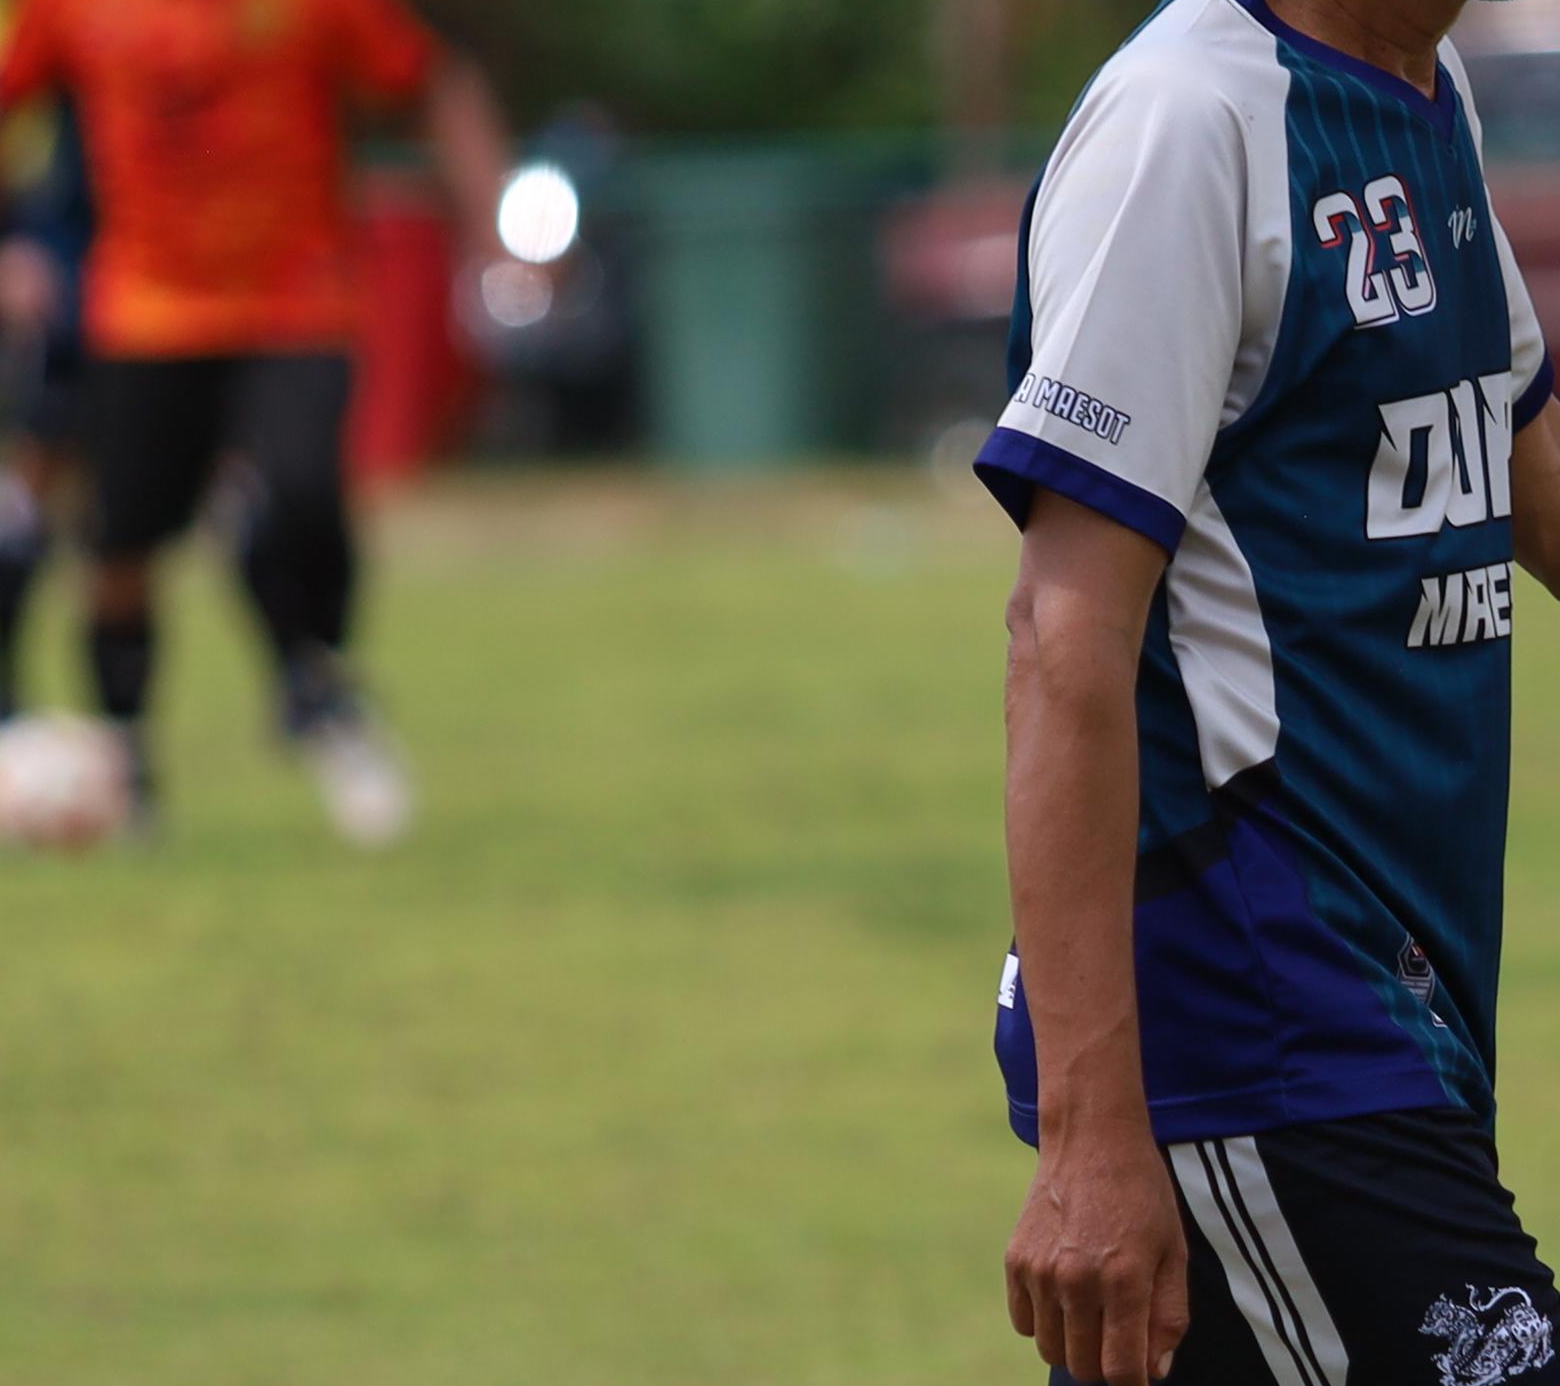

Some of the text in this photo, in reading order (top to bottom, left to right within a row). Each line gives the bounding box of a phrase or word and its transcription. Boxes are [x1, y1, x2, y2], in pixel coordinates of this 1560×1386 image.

[1312, 174, 1437, 330] 23
[1033, 376, 1131, 445] MAESOT
[1407, 560, 1515, 647] MAE
